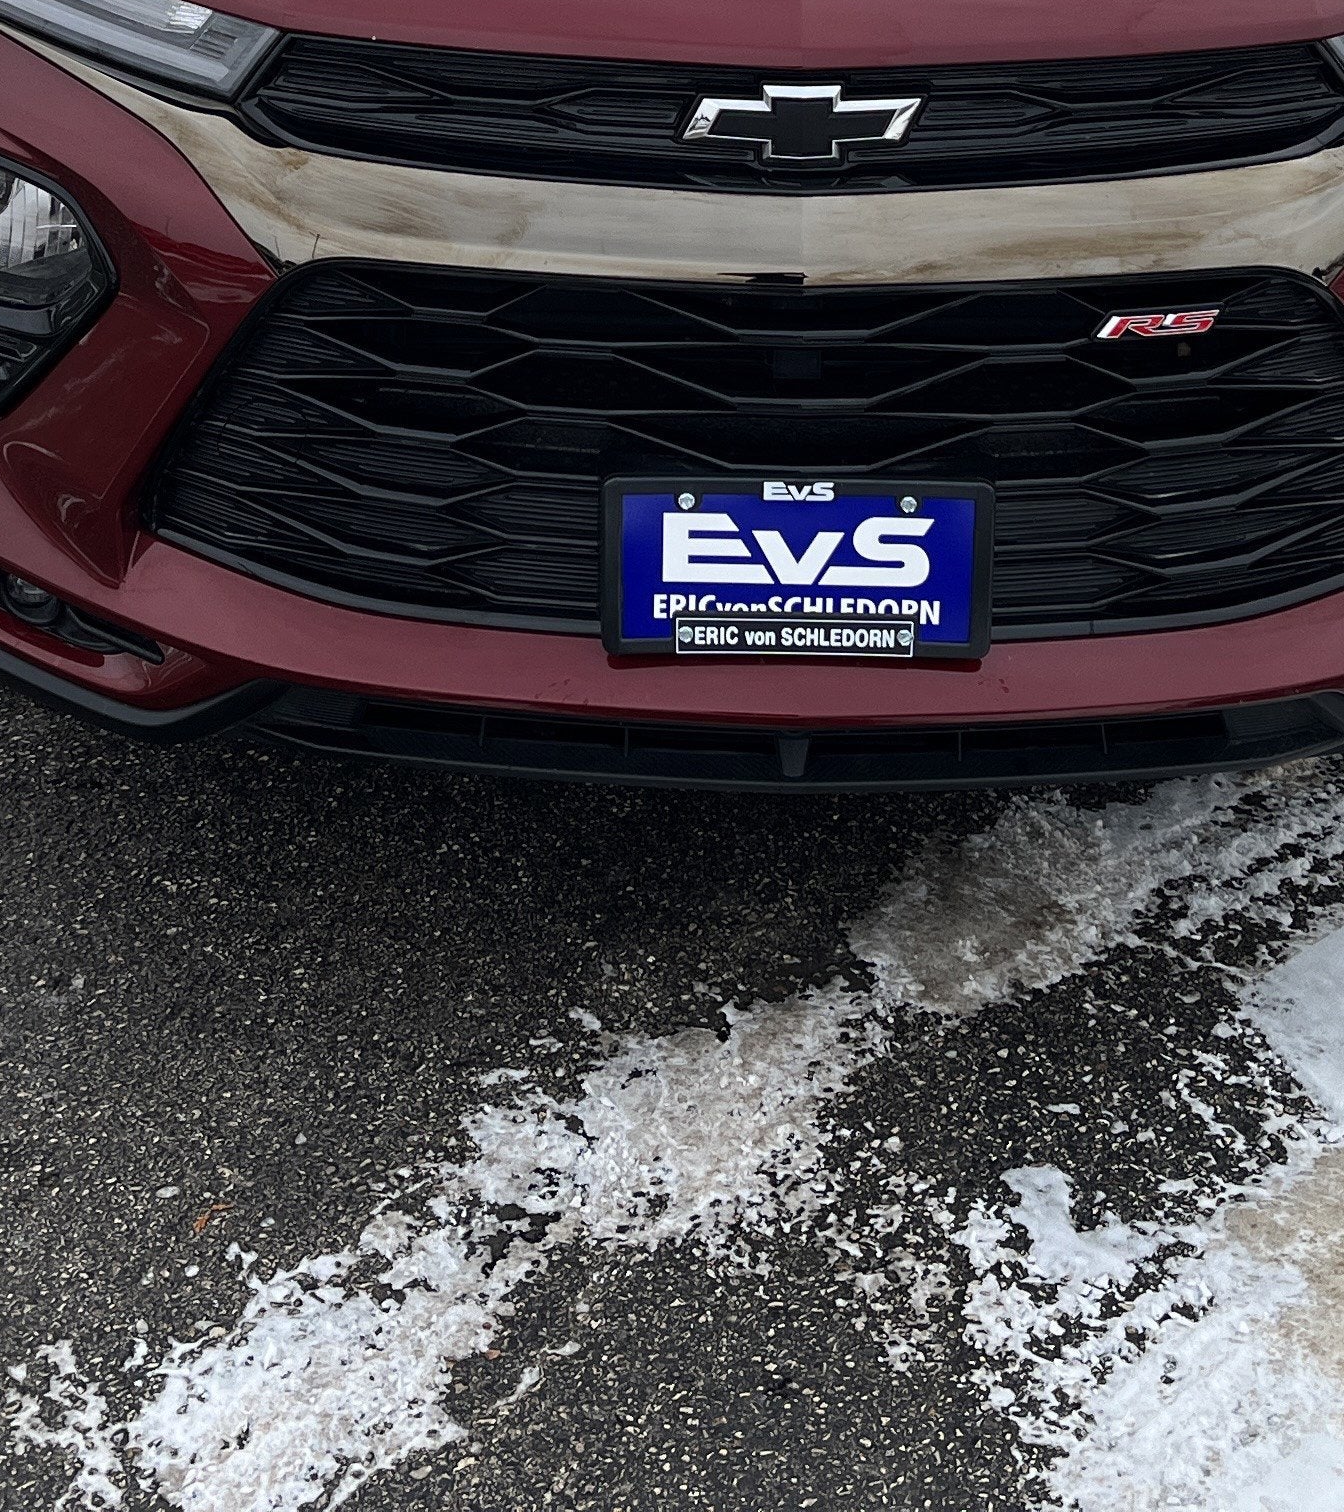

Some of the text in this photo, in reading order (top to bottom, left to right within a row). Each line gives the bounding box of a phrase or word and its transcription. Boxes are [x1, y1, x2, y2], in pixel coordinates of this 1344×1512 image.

[1097, 309, 1220, 339] RS
[694, 626, 896, 649] ERIC von SCHLEDORN
